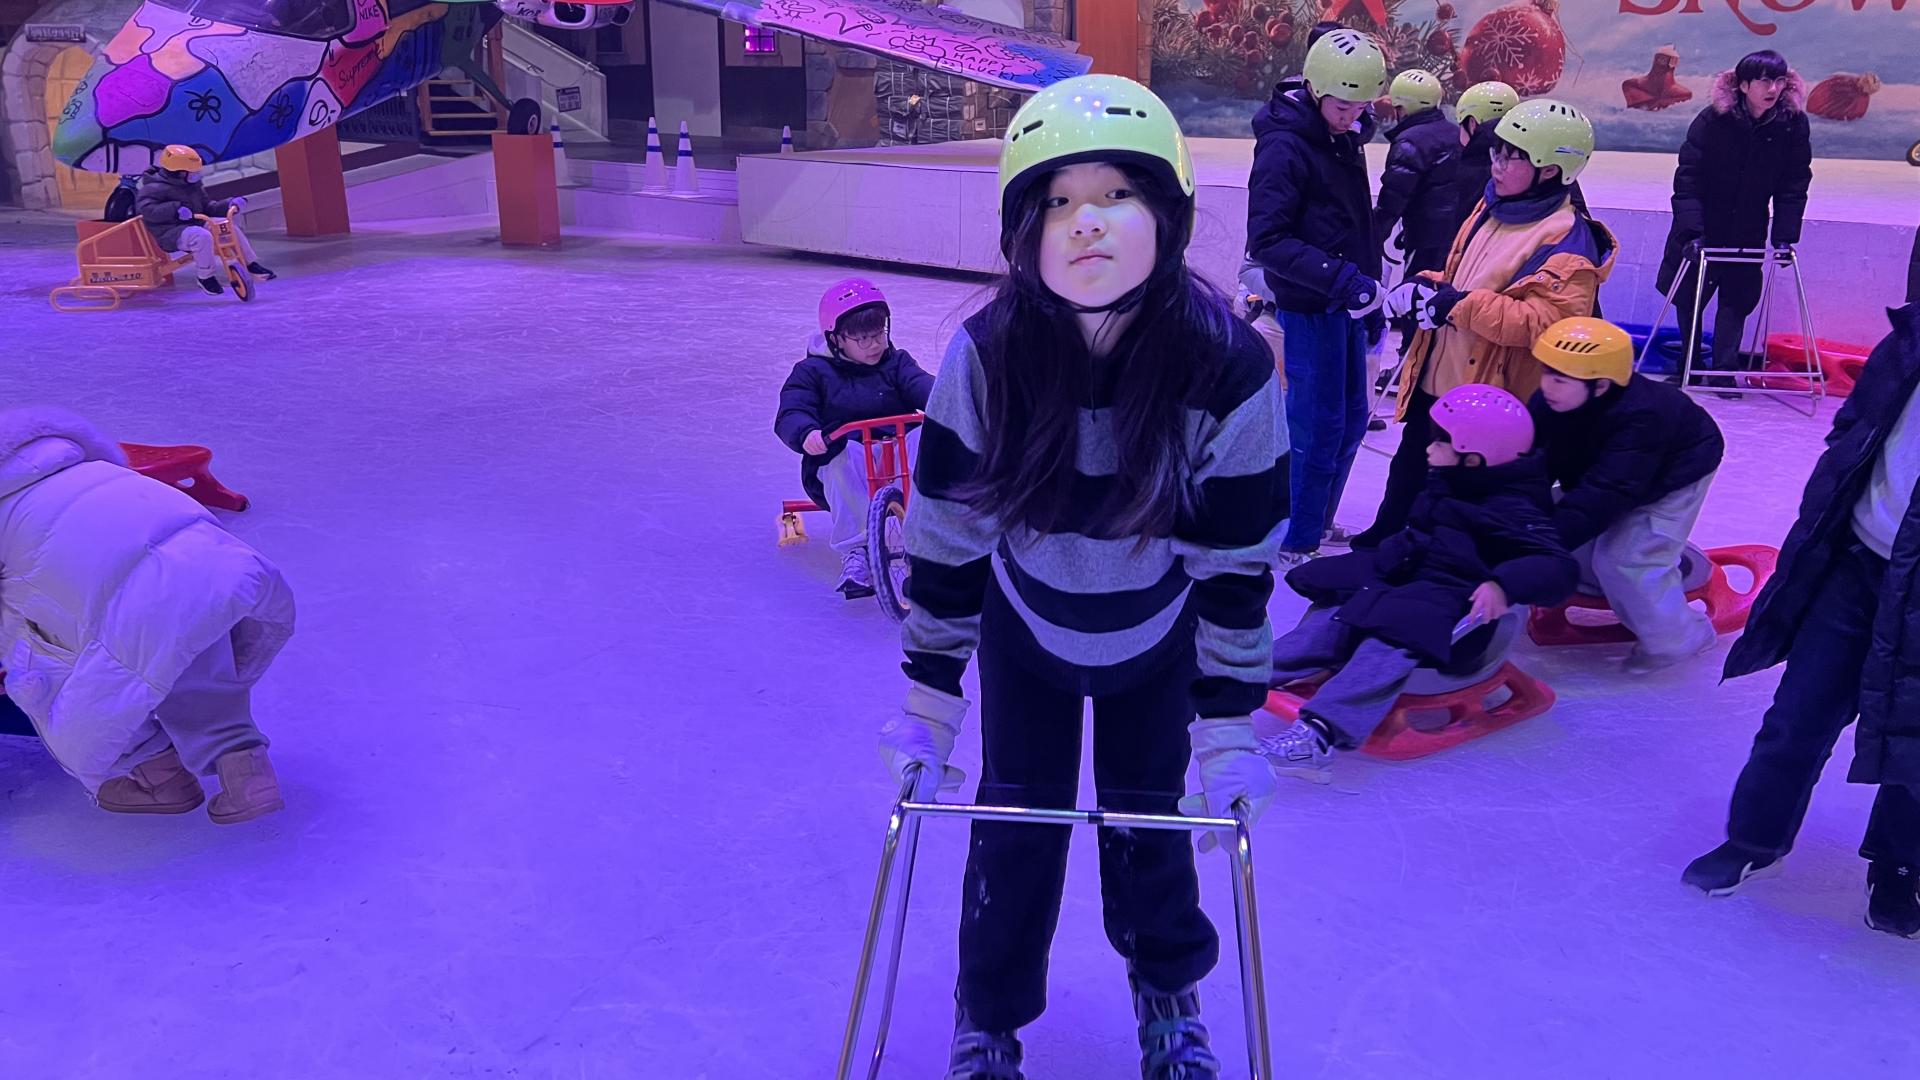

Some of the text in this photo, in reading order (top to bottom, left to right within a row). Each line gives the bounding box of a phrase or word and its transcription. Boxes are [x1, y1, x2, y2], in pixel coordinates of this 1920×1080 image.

[359, 4, 380, 21] NIKE
[953, 52, 1012, 71] HAPPY
[968, 64, 1021, 81] LUCKY
